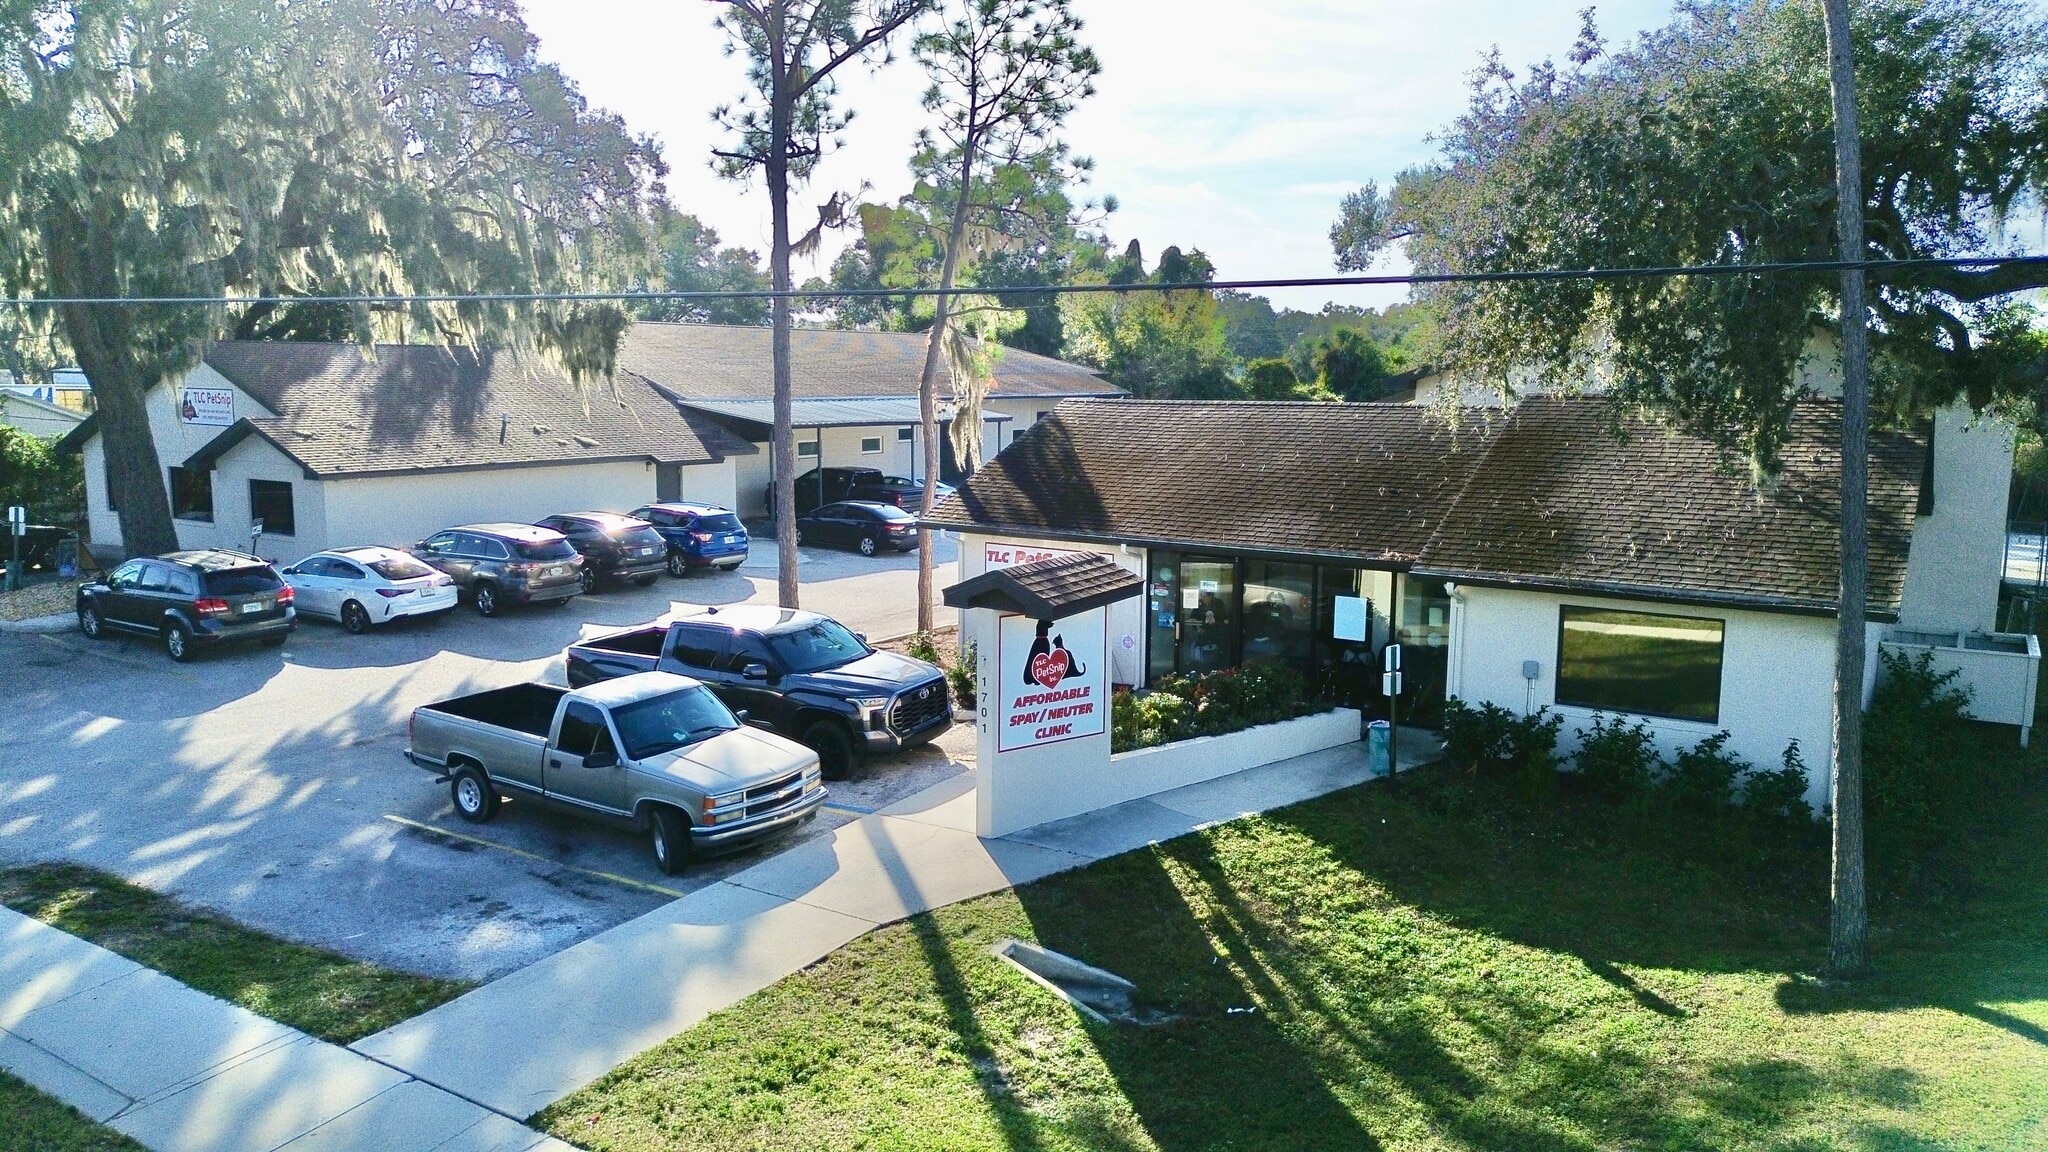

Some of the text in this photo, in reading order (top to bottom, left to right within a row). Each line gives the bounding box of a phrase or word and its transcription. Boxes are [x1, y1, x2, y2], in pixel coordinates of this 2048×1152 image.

[193, 391, 231, 408] TLC PetSnip
[987, 550, 1053, 564] TLC PetS
[1035, 659, 1047, 667] TLC
[1036, 662, 1065, 679] PetSnip
[1013, 686, 1091, 709] AFFORDABLE
[1035, 723, 1073, 739] CLINIC
